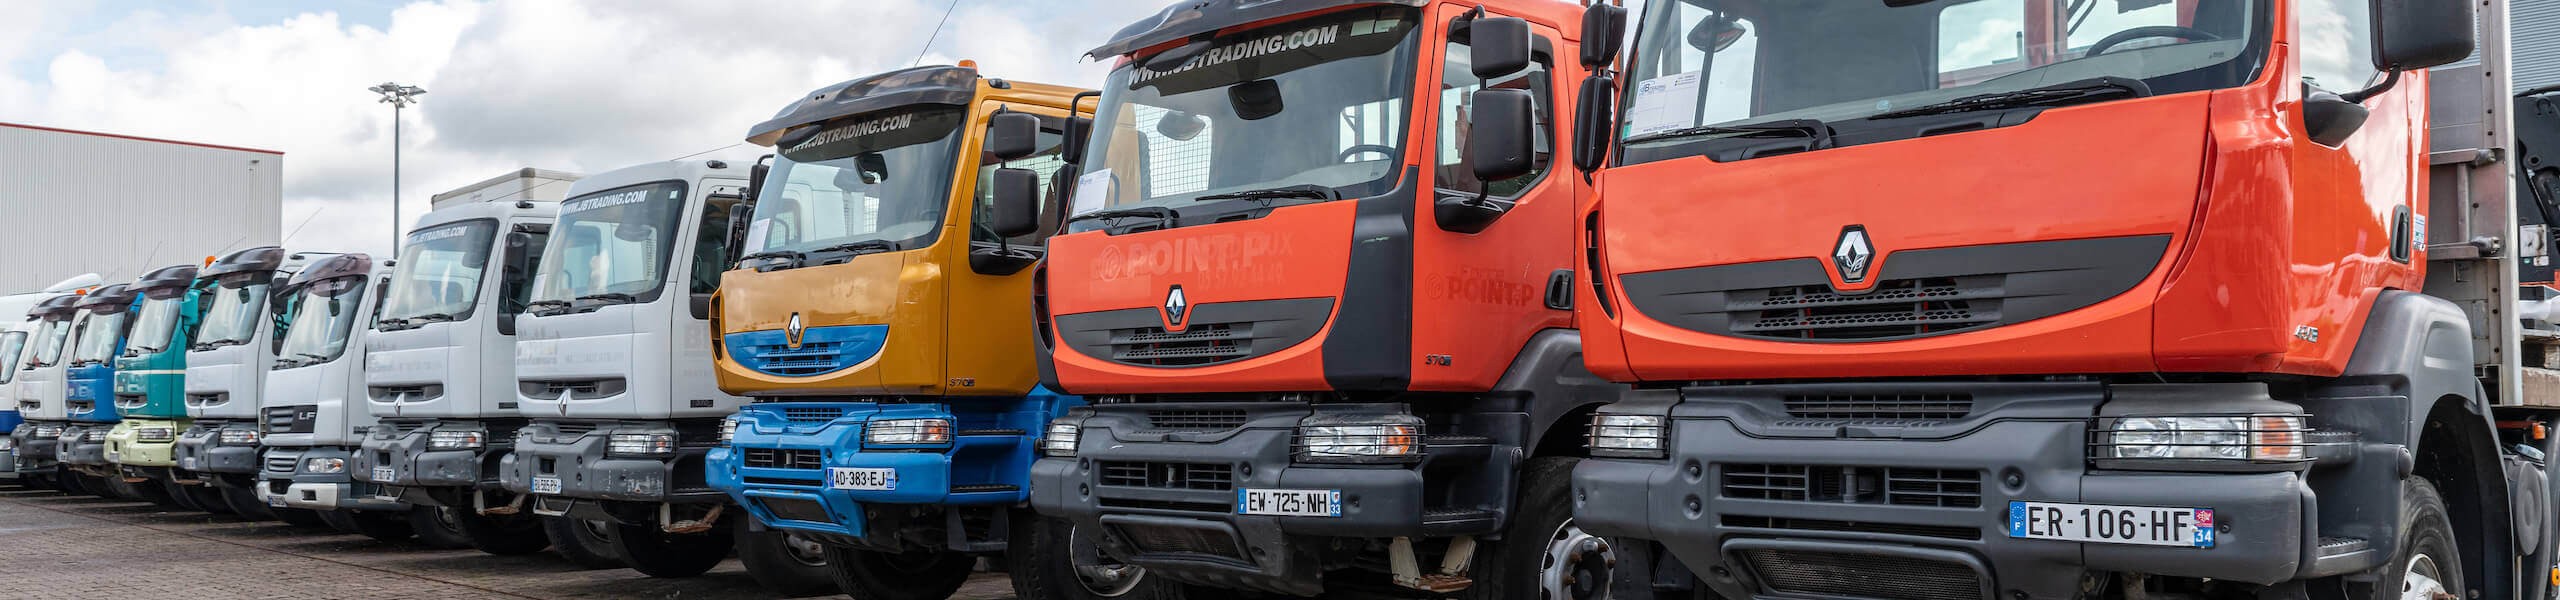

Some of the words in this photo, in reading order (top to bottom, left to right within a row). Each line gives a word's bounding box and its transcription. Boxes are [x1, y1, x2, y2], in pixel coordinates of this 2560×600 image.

[299, 411, 316, 421] LF
[1330, 504, 1341, 514] 33
[2014, 521, 2021, 531] F
[2028, 506, 2191, 542] ER-106-HF
[2195, 528, 2212, 543] 34
